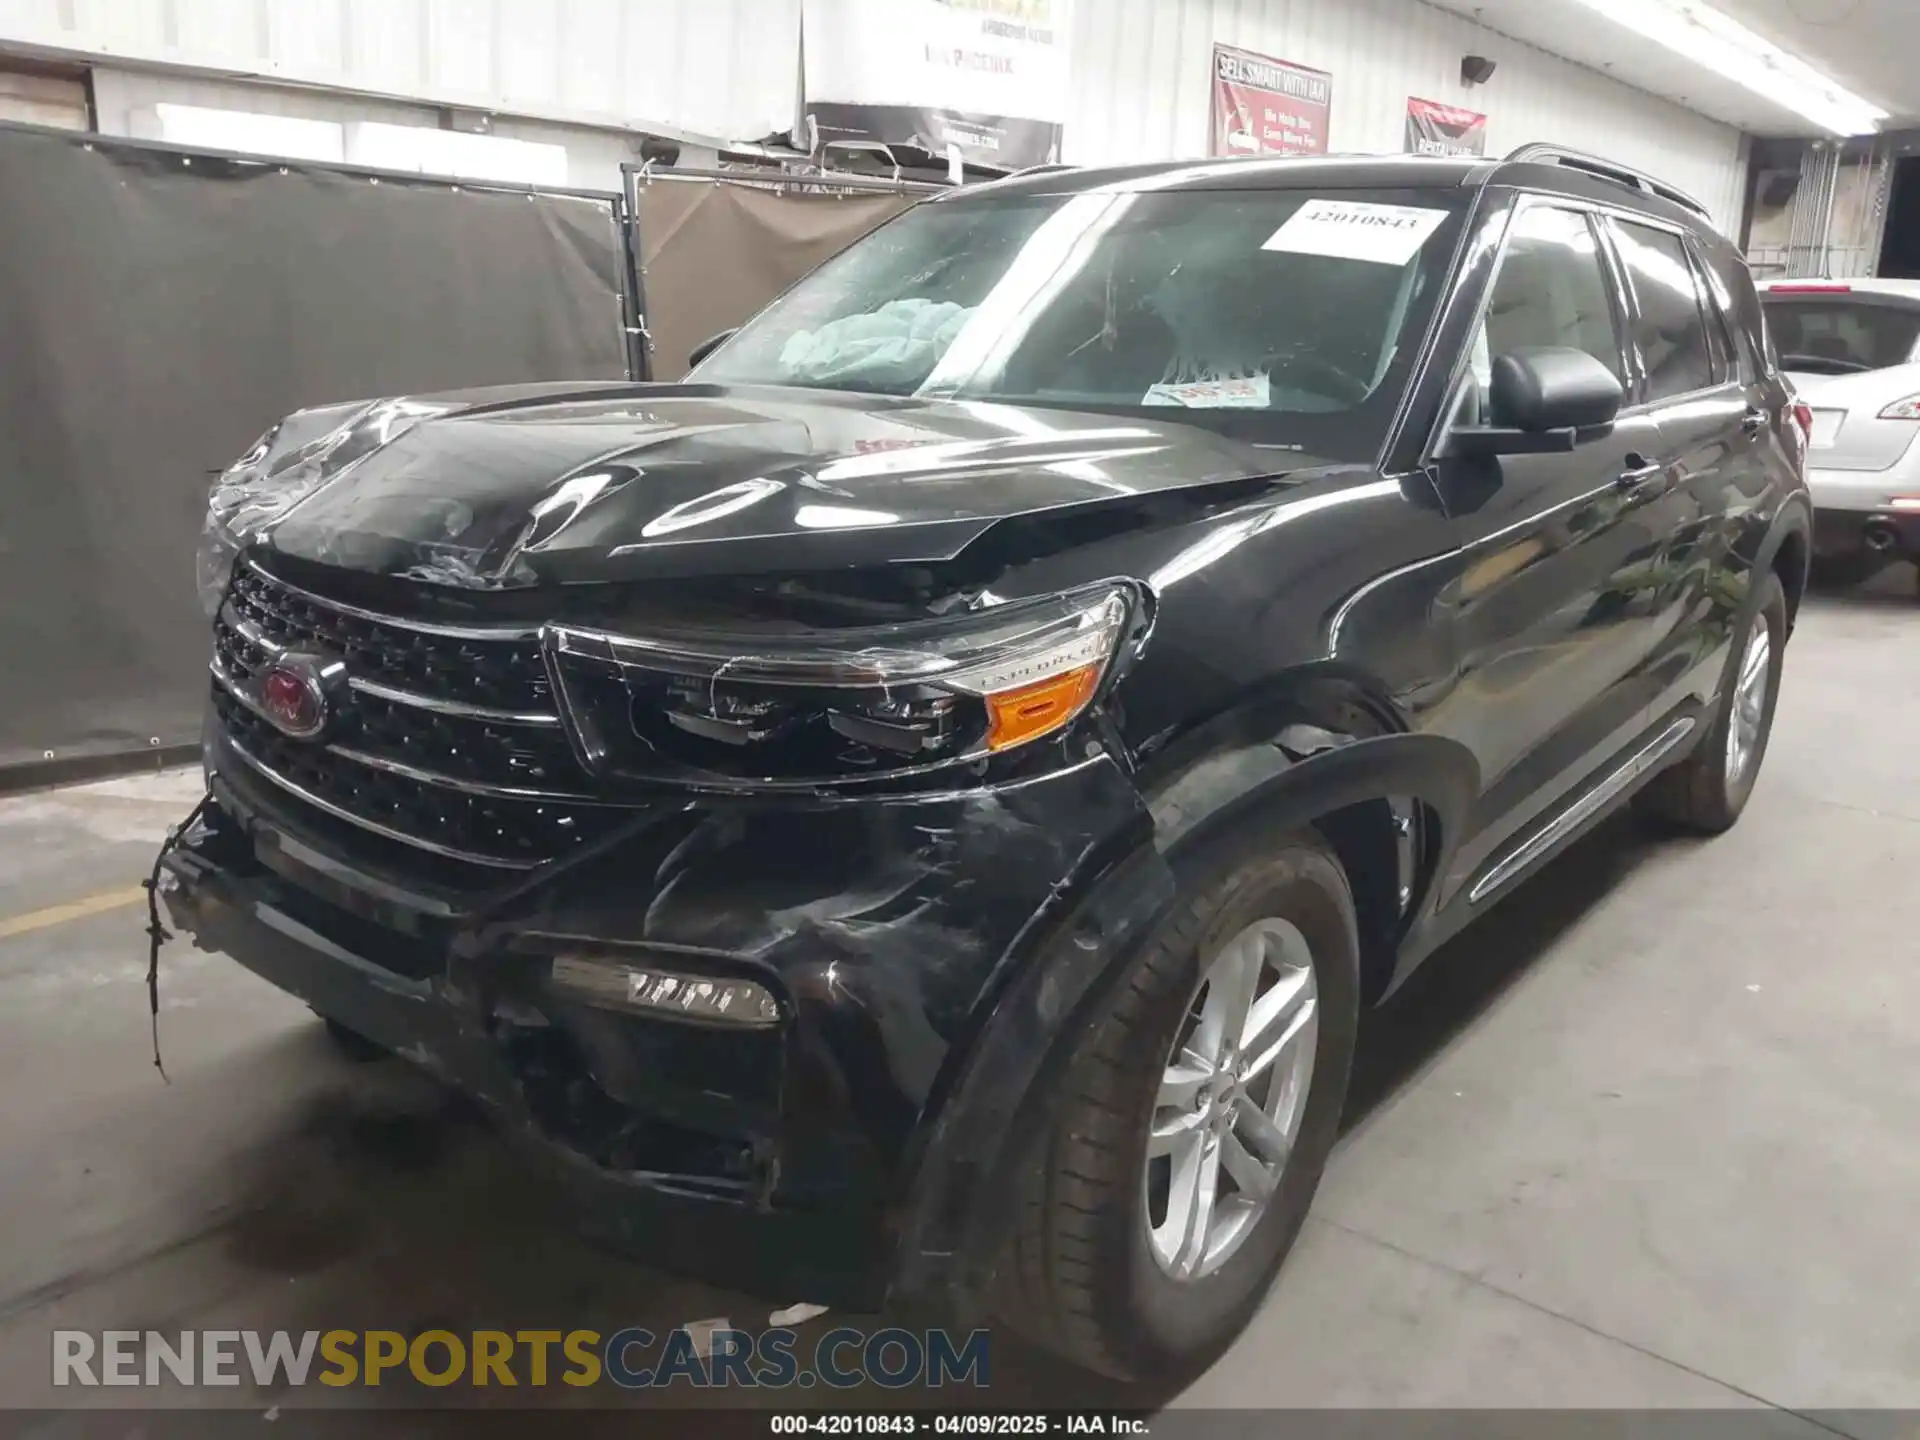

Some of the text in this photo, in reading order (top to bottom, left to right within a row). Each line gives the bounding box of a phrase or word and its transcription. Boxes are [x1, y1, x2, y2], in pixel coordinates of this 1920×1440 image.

[1219, 55, 1325, 101] SELL SMART WITH IAA
[1305, 211, 1417, 230] 42010843
